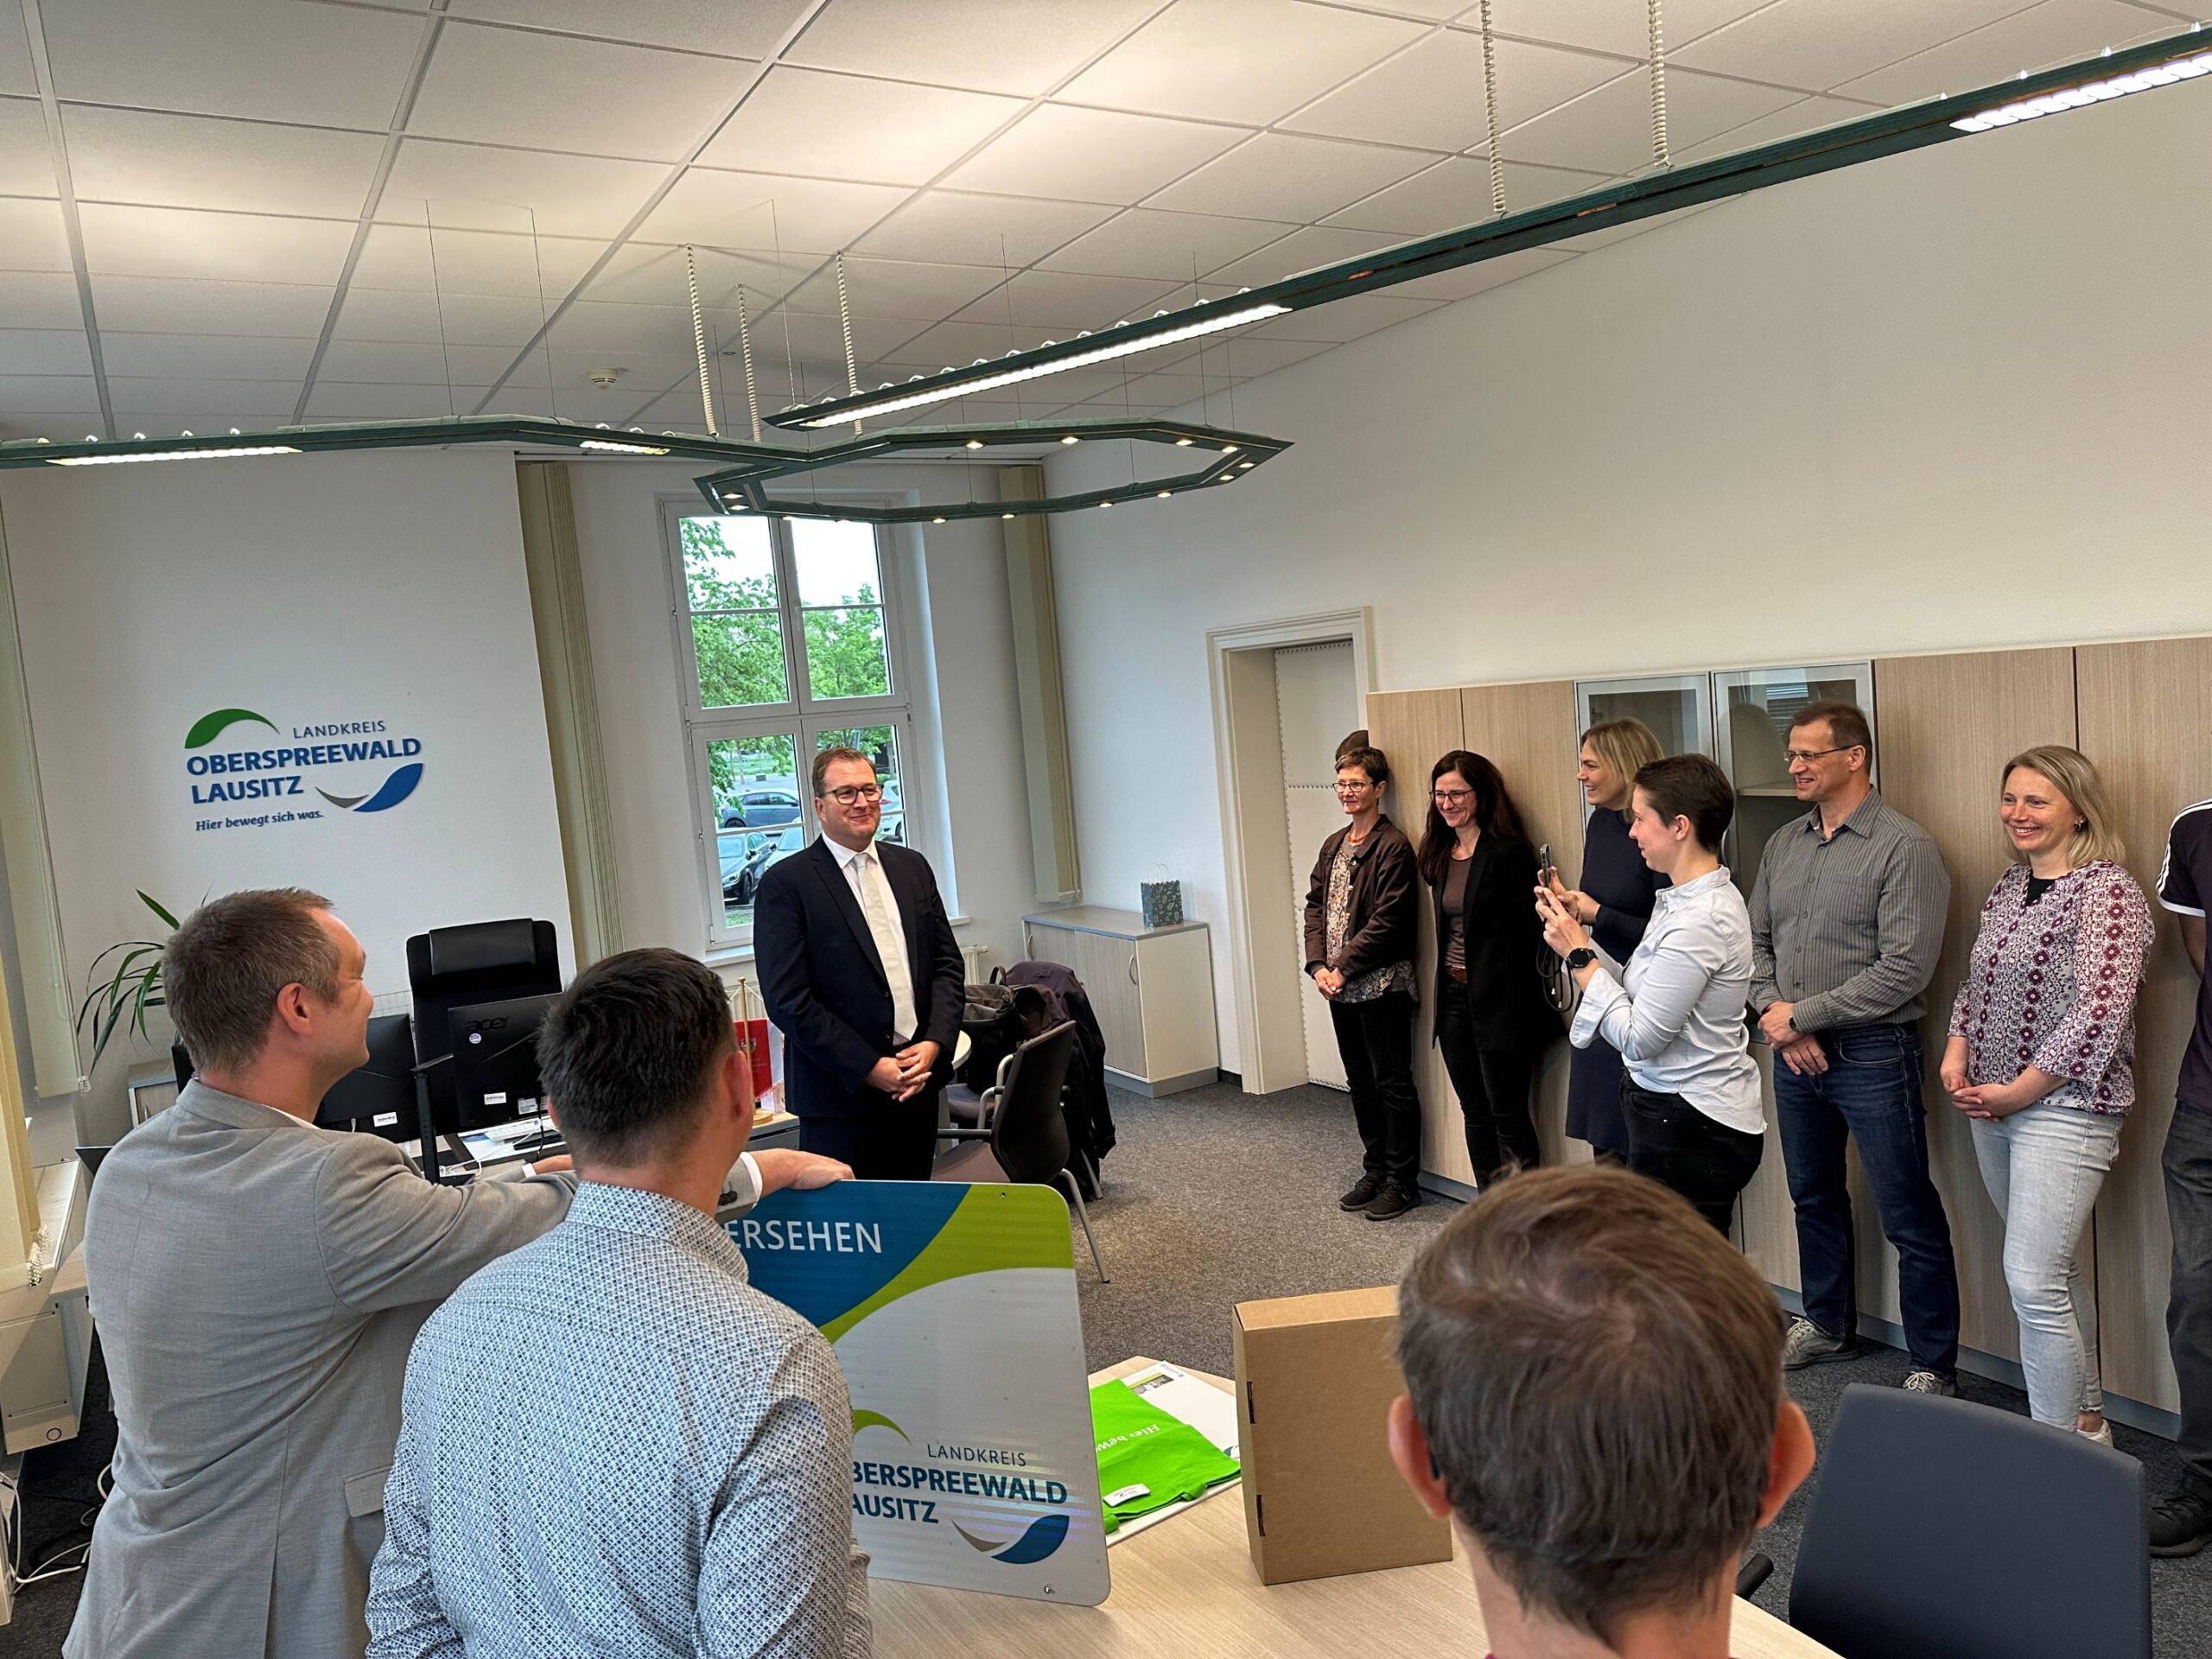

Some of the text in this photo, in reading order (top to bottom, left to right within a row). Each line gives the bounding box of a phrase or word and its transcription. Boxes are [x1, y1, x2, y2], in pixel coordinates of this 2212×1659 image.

[293, 721, 385, 739] LANDKREIS
[187, 738, 422, 776] OBERSPREEWALD
[191, 775, 304, 804] LAUSITZ
[195, 810, 324, 831] Hier bewegt sich was.
[467, 1017, 508, 1031] acer
[723, 1219, 882, 1254] ERSEHEN
[927, 1443, 1027, 1467] LANDKREIS
[1096, 1435, 1128, 1452] bew
[852, 1461, 1067, 1504] BERSPREEWALD
[852, 1493, 939, 1524] AUSITZ
